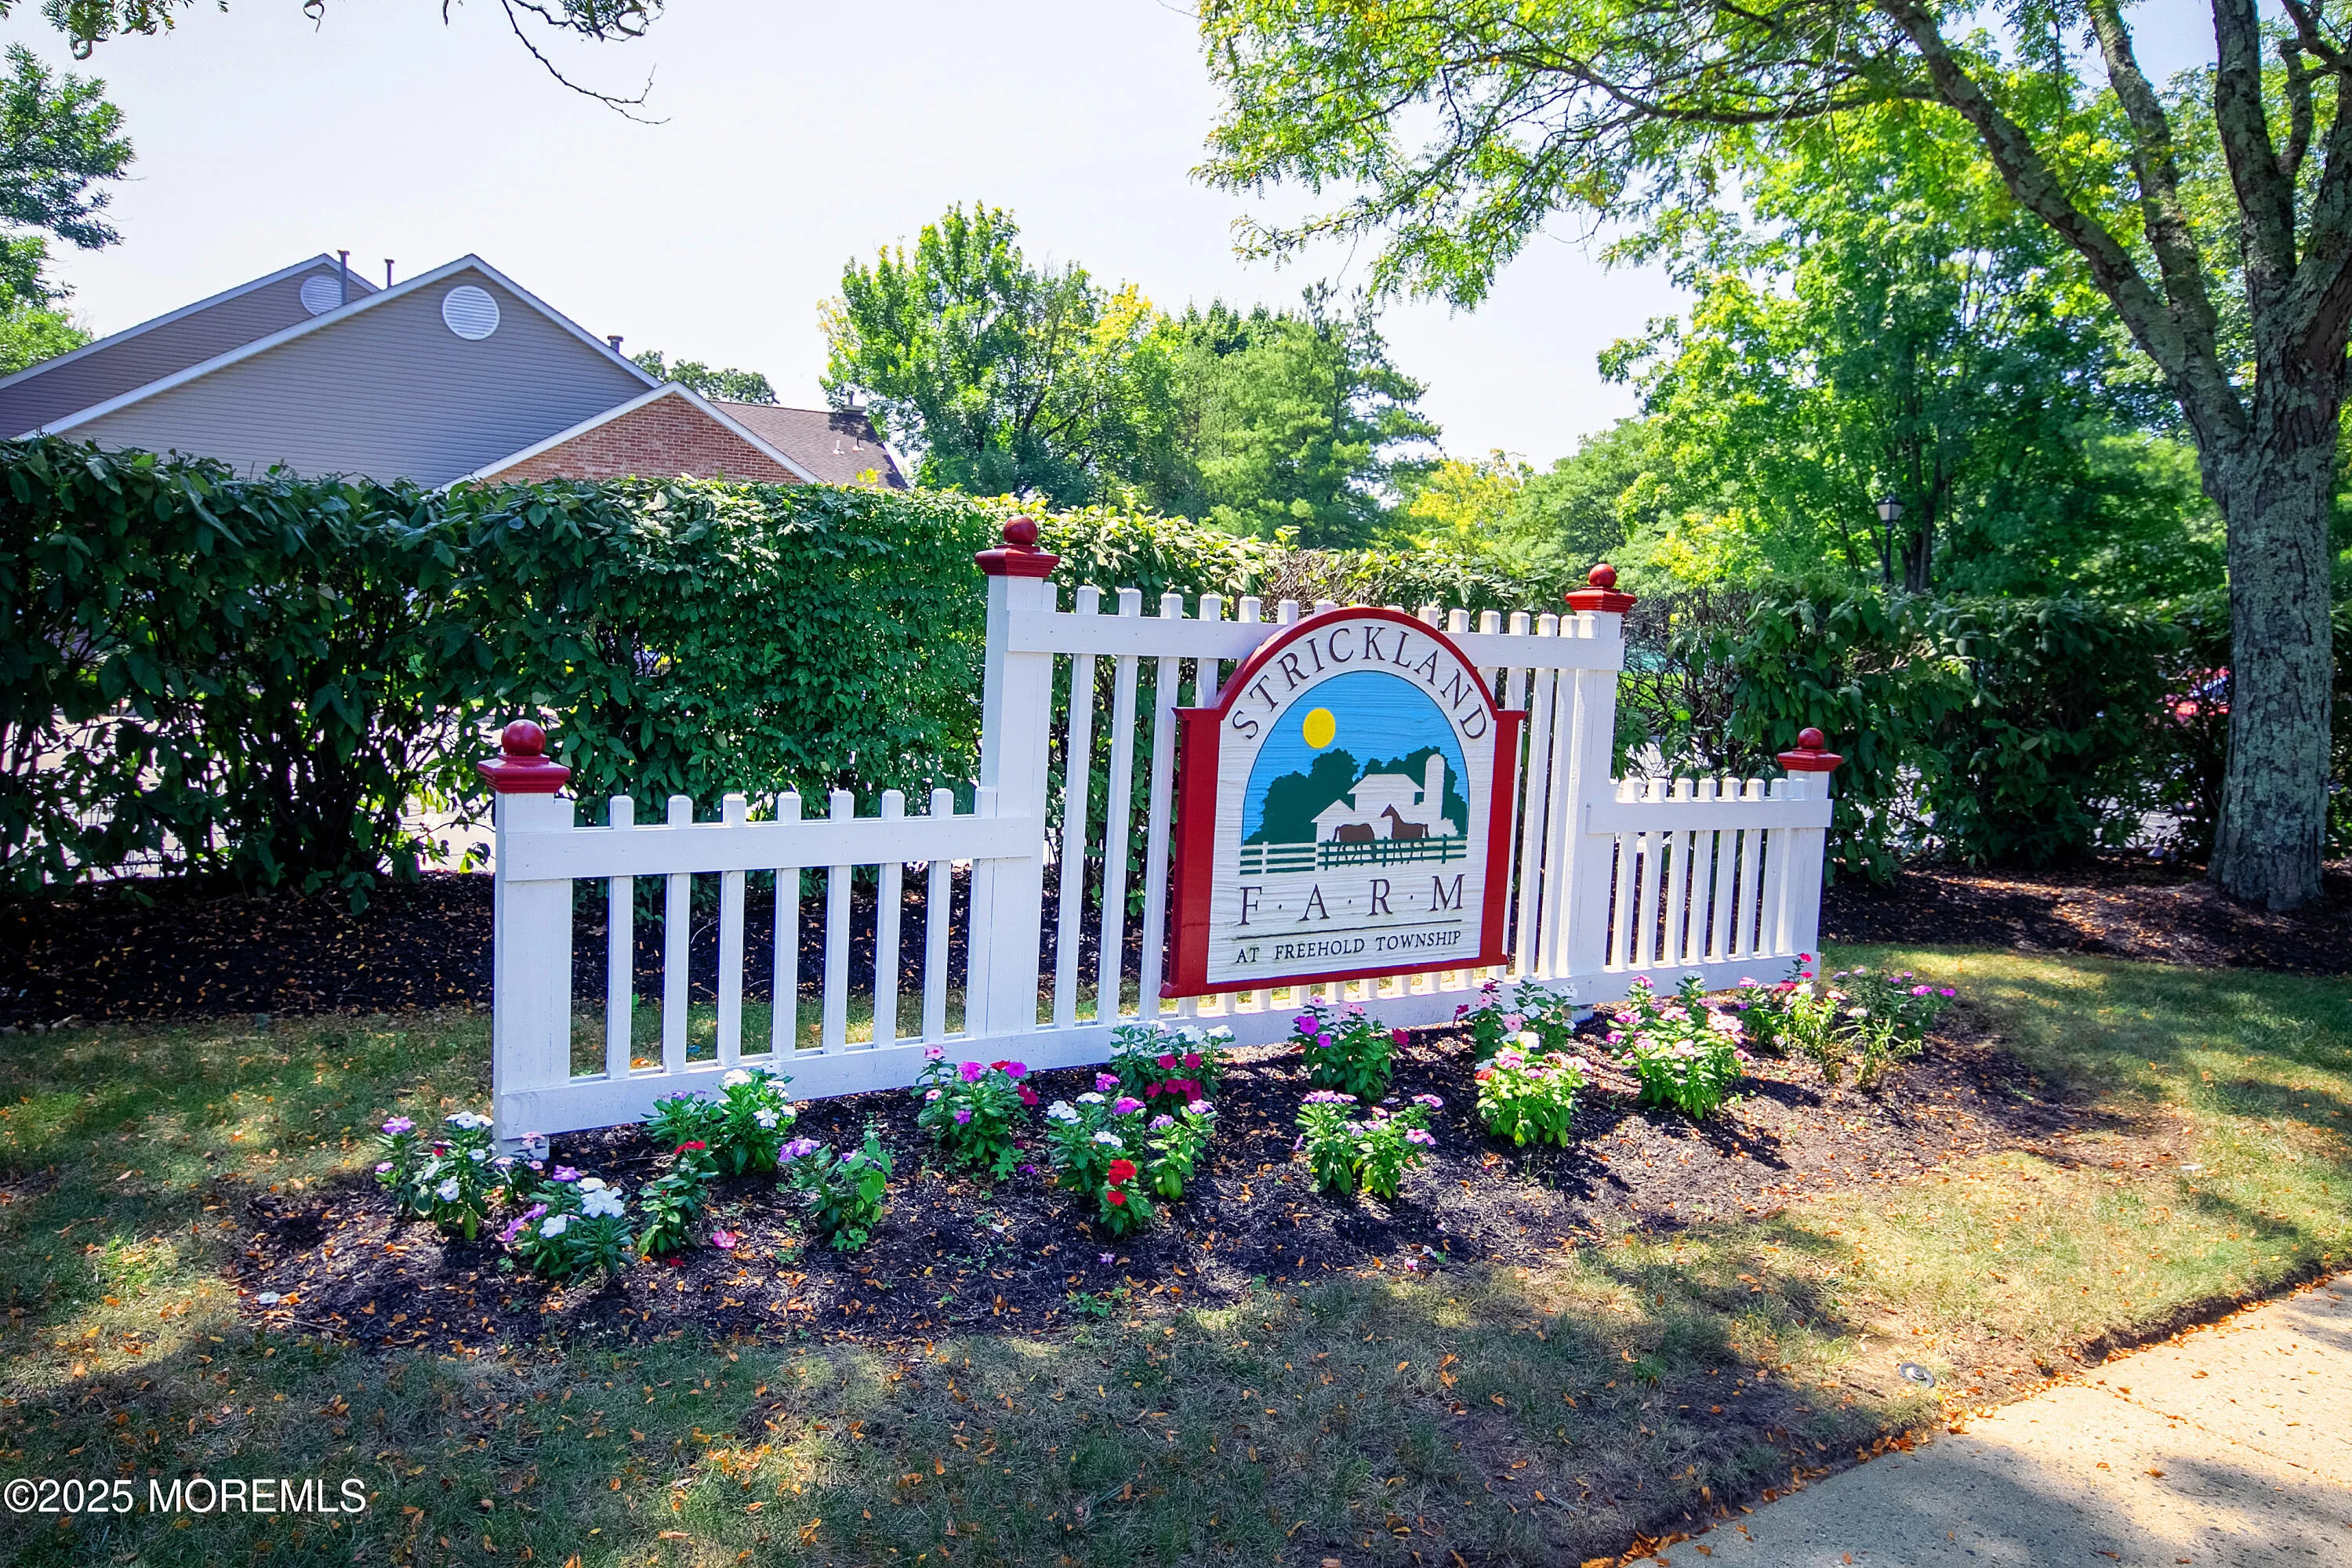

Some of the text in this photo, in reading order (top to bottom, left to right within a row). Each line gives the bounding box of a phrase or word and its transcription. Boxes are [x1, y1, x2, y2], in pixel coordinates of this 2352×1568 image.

[1232, 626, 1486, 740] STRICKLAND
[1235, 930, 1462, 964] AT FREEHOLD TOWNSHIP
